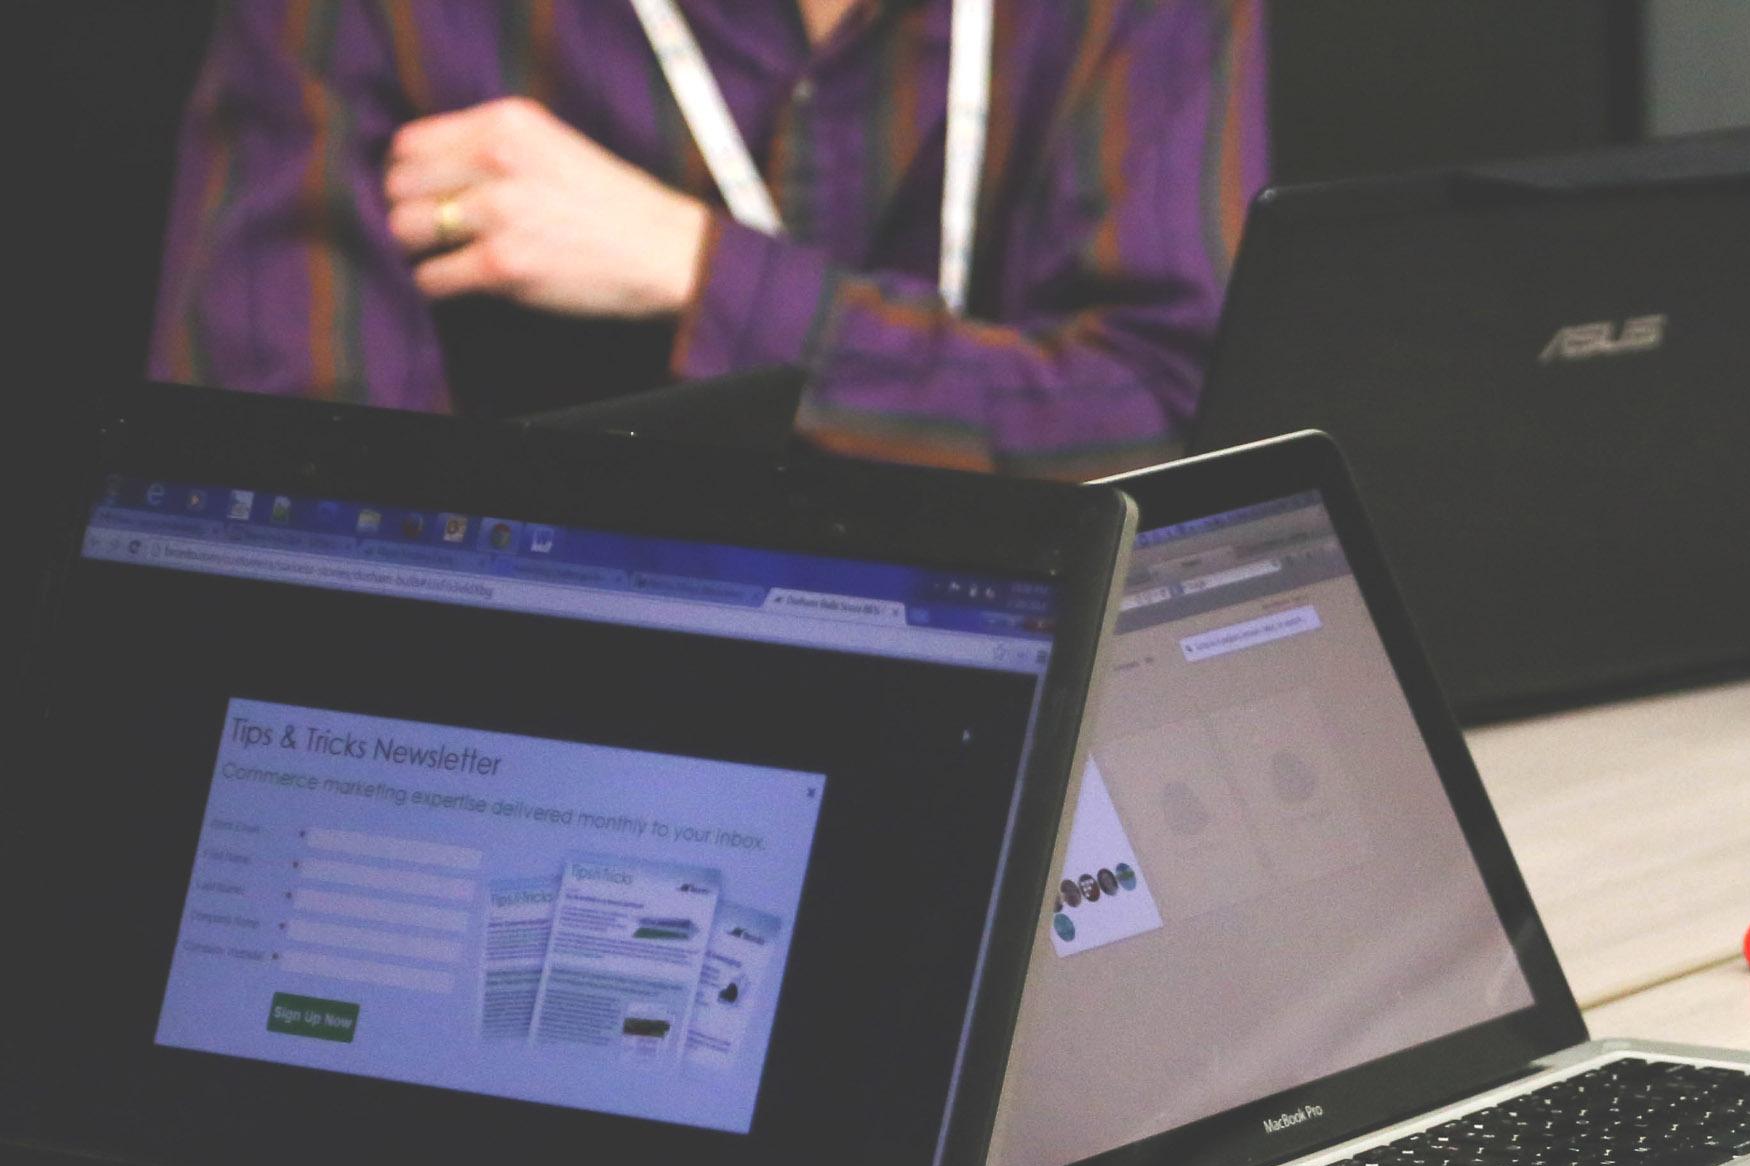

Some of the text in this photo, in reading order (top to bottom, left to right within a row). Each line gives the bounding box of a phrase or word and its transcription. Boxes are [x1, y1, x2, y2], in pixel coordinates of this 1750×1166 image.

[232, 717, 501, 776] Tips & Tricks Newsletter
[222, 762, 317, 791] Commerce
[323, 776, 406, 806] marketing
[411, 788, 486, 813] expertise
[493, 799, 572, 825] delivered
[578, 811, 647, 837] monthly
[652, 820, 669, 837] to
[673, 828, 711, 845] your
[273, 1006, 353, 1028] Sign Up Now
[1263, 1105, 1323, 1134] MacBook Pro
